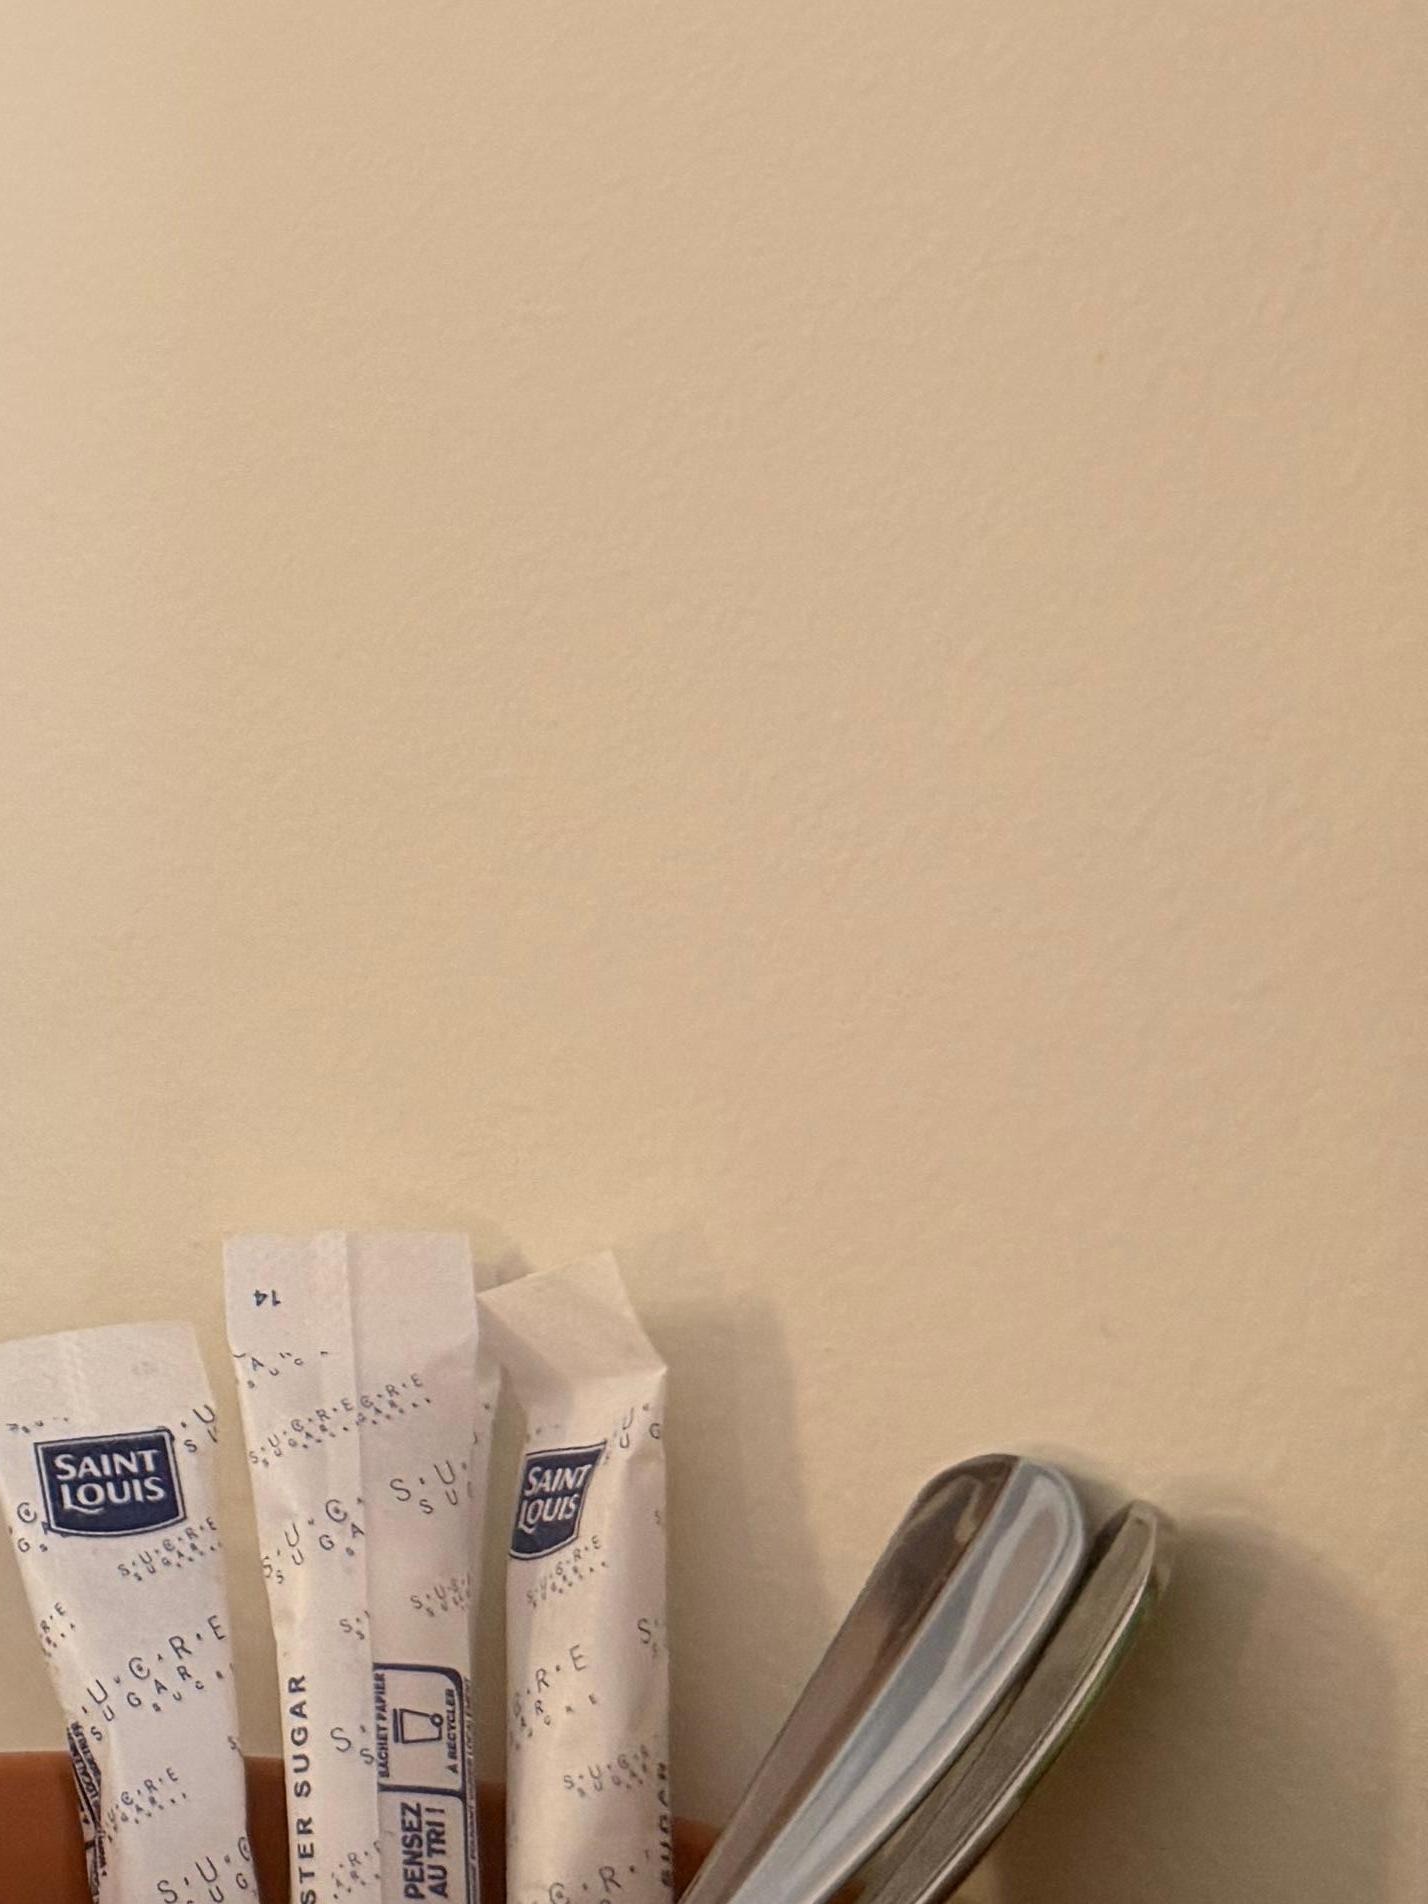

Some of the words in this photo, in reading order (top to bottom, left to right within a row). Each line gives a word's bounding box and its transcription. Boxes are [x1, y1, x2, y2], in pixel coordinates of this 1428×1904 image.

[54, 1449, 159, 1481] SAINT
[524, 1464, 592, 1495] SAINT
[60, 1476, 166, 1516] LOUIS
[518, 1494, 579, 1534] LOUIS
[372, 1672, 387, 1721] PAPIER
[288, 1674, 313, 1798] SUGAR
[401, 1802, 426, 1899] PENSEZ
[426, 1821, 448, 1860] TRI
[427, 1865, 449, 1898] AU
